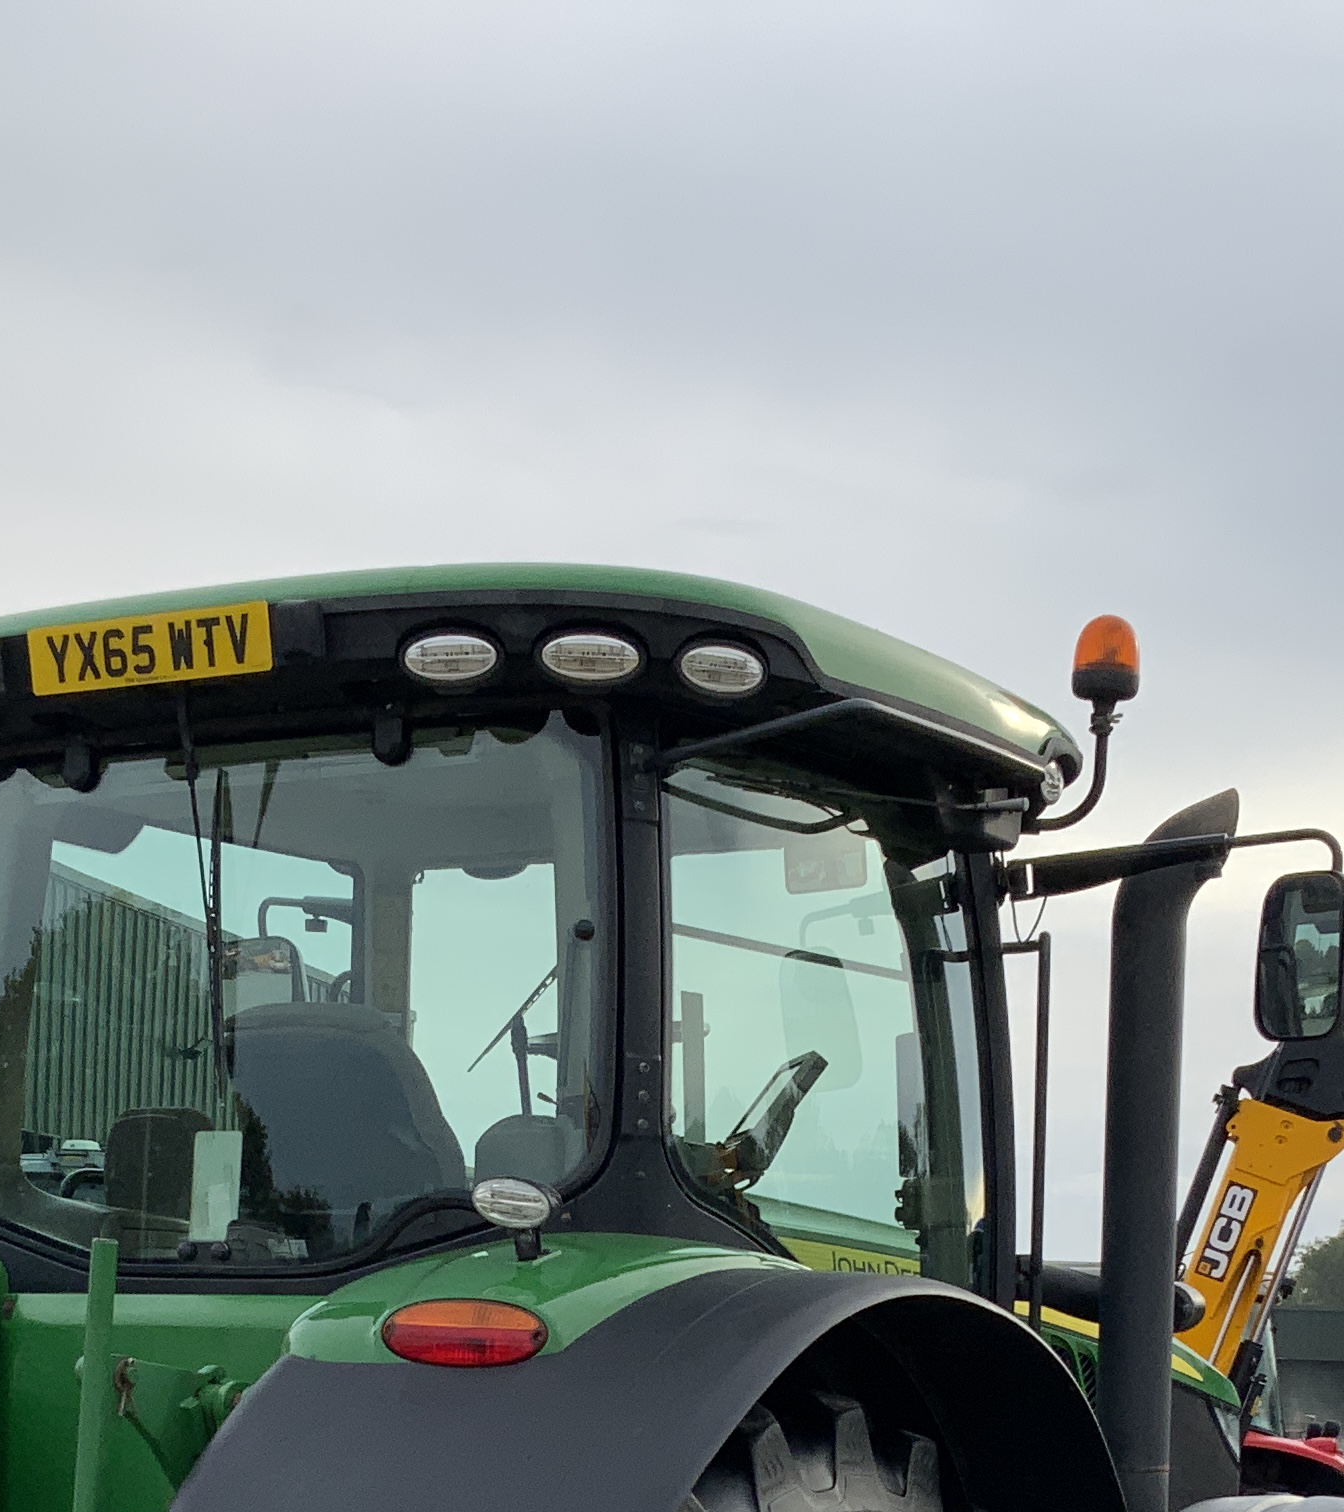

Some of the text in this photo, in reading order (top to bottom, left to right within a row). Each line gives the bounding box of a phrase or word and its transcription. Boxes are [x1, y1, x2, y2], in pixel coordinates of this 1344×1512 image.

[46, 612, 249, 684] YX65 WTV
[1203, 1185, 1254, 1279] JCB
